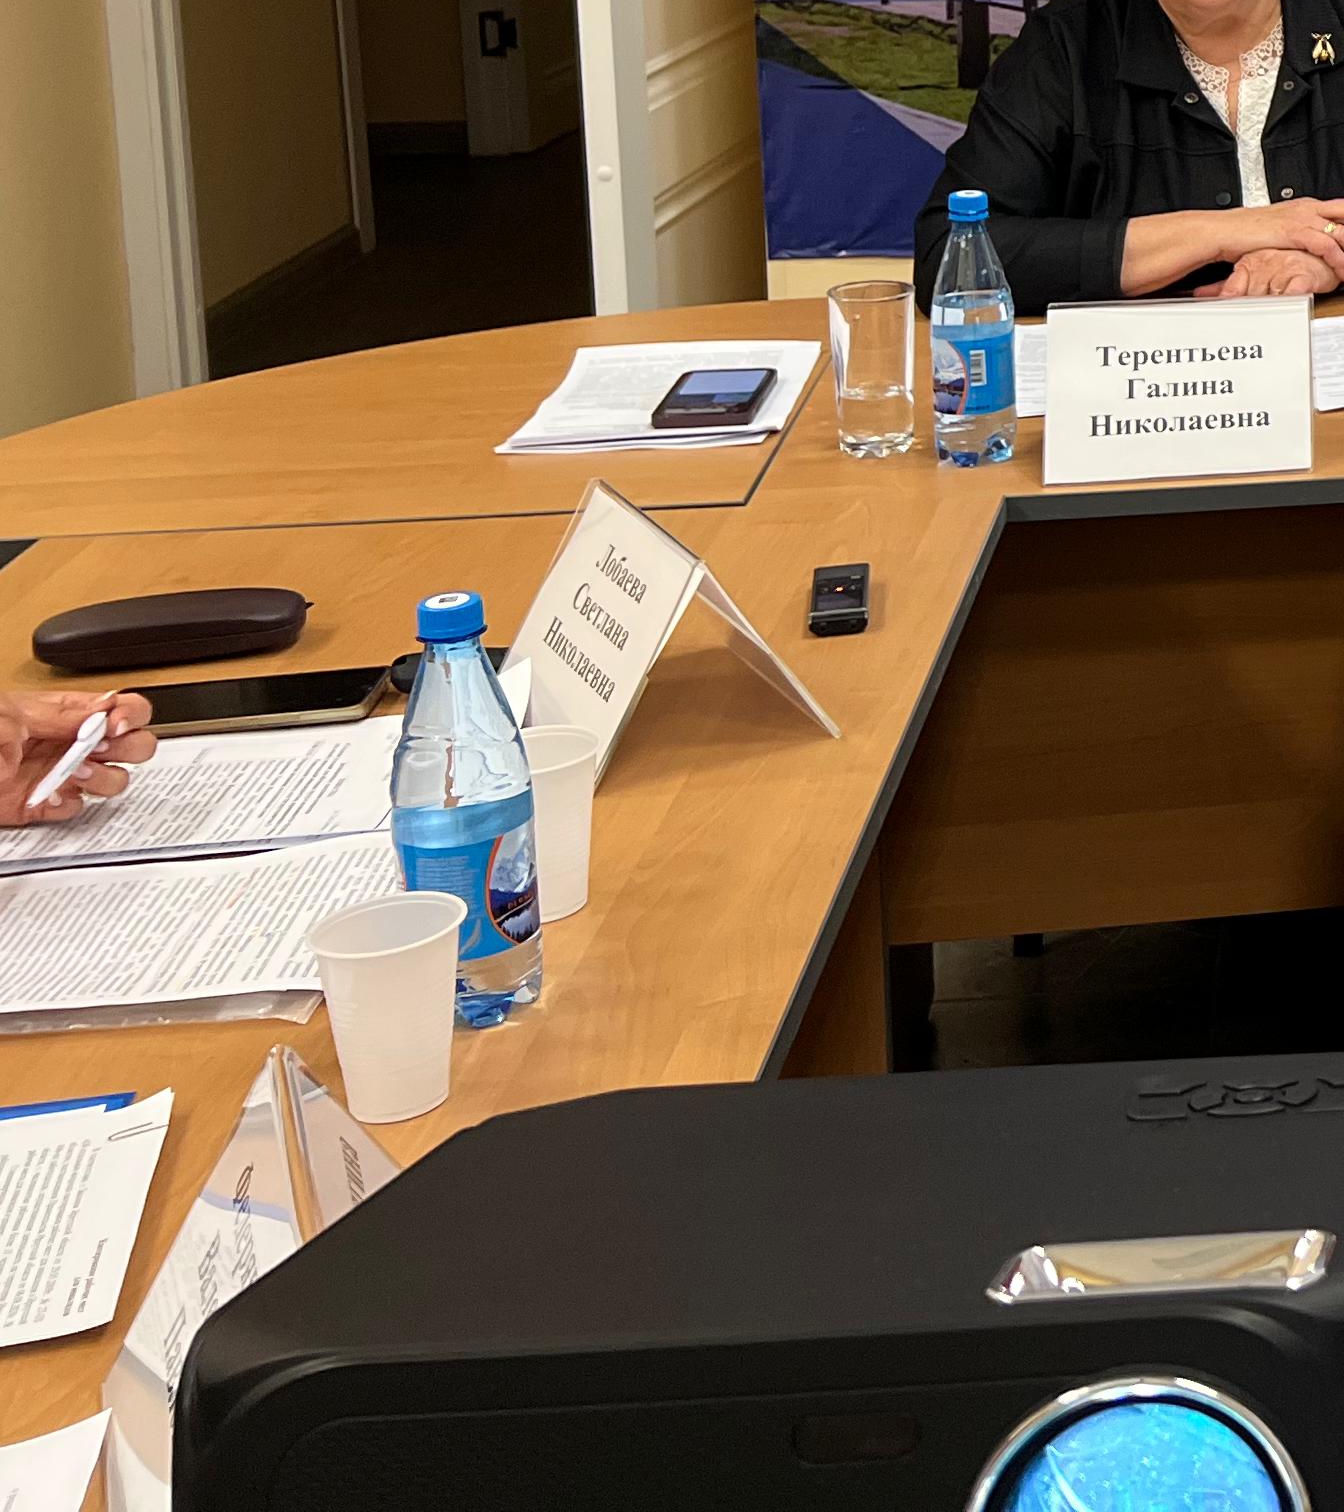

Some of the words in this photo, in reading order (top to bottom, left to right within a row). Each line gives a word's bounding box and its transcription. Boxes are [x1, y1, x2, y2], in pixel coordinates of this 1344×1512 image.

[1094, 344, 1264, 371] Терентьева
[1125, 378, 1234, 399] Галина
[1088, 410, 1270, 437] Николаевна
[595, 544, 647, 604] Лобаева
[572, 583, 630, 651] Светлана
[543, 616, 616, 703] Николаевна
